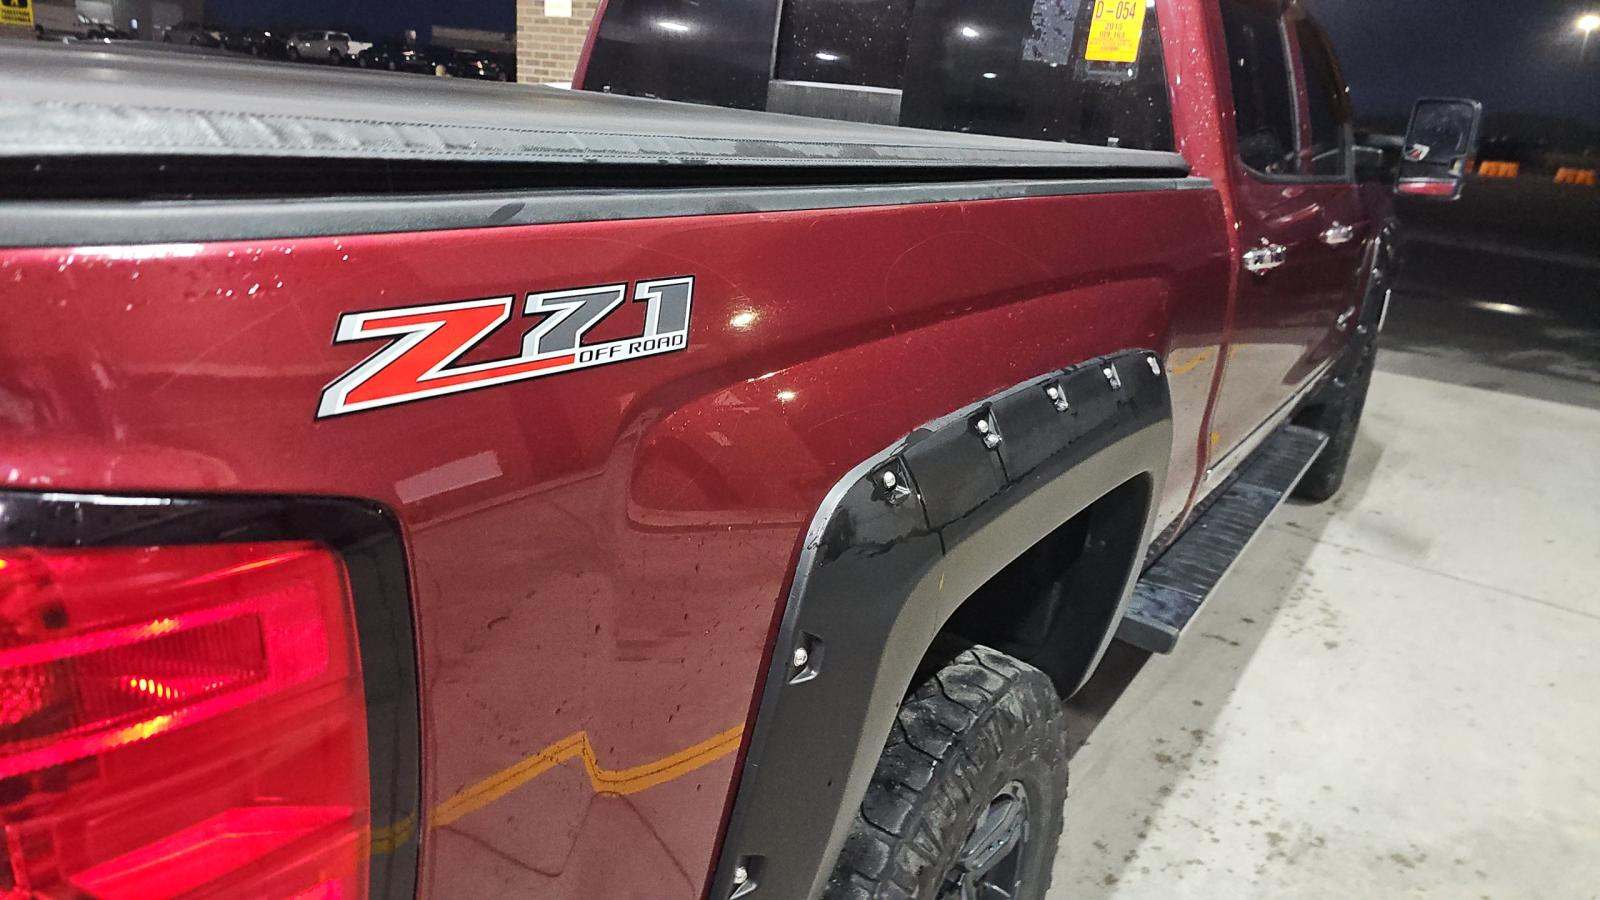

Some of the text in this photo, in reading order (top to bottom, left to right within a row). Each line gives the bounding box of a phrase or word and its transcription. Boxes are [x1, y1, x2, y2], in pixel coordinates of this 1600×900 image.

[315, 275, 695, 420] Z71
[578, 333, 685, 365] OFF ROAD
